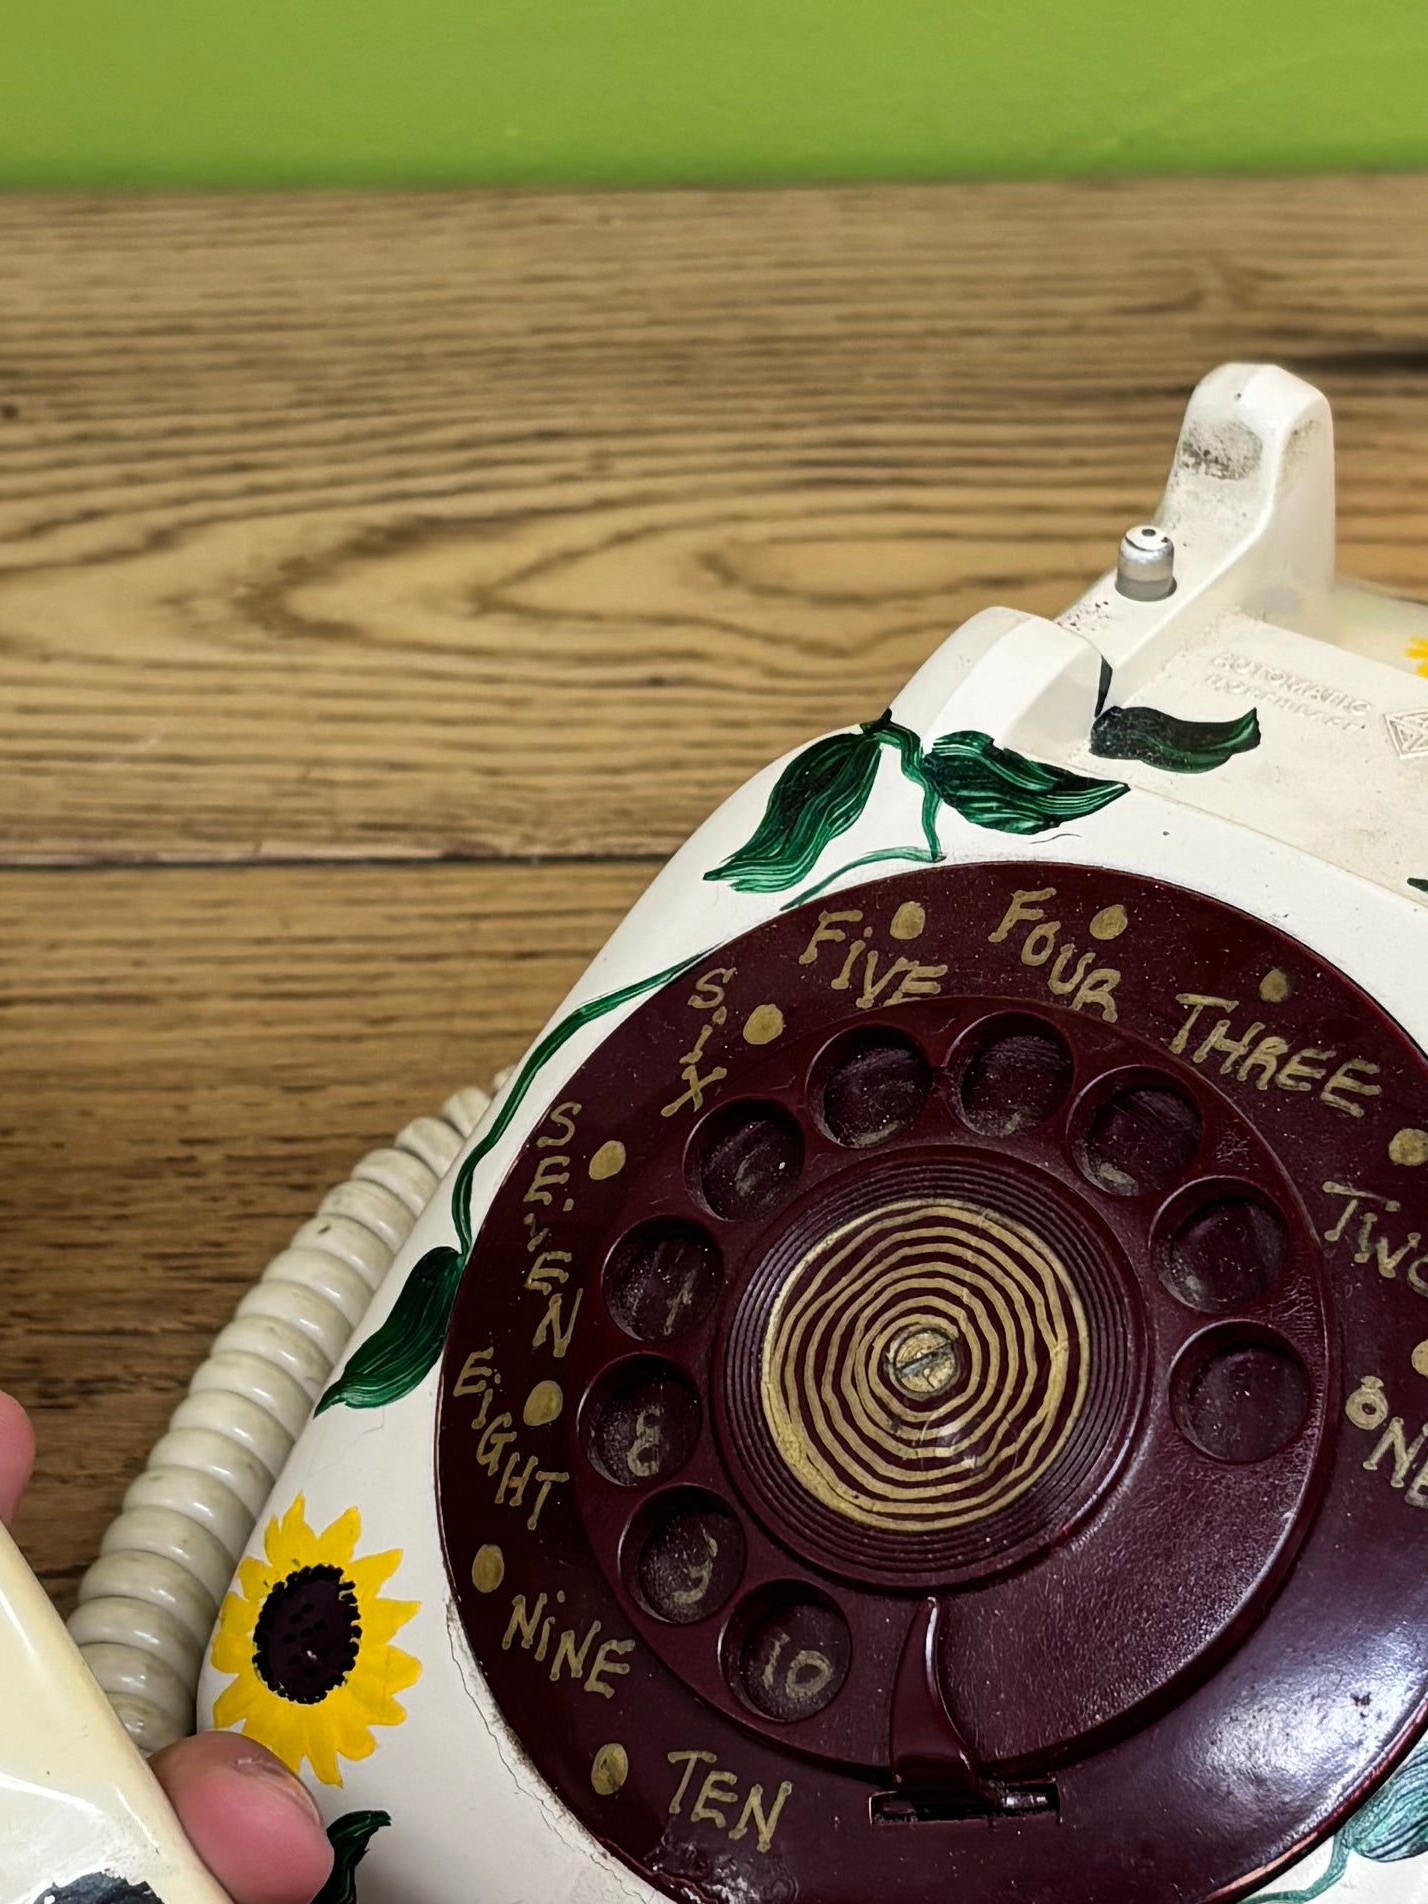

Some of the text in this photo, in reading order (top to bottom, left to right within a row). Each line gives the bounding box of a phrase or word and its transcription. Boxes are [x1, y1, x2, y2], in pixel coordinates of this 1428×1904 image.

[988, 887, 1122, 1024] FOUR
[1168, 992, 1383, 1118] THREE
[762, 1631, 834, 1699] 10
[667, 1749, 794, 1854] TEN
